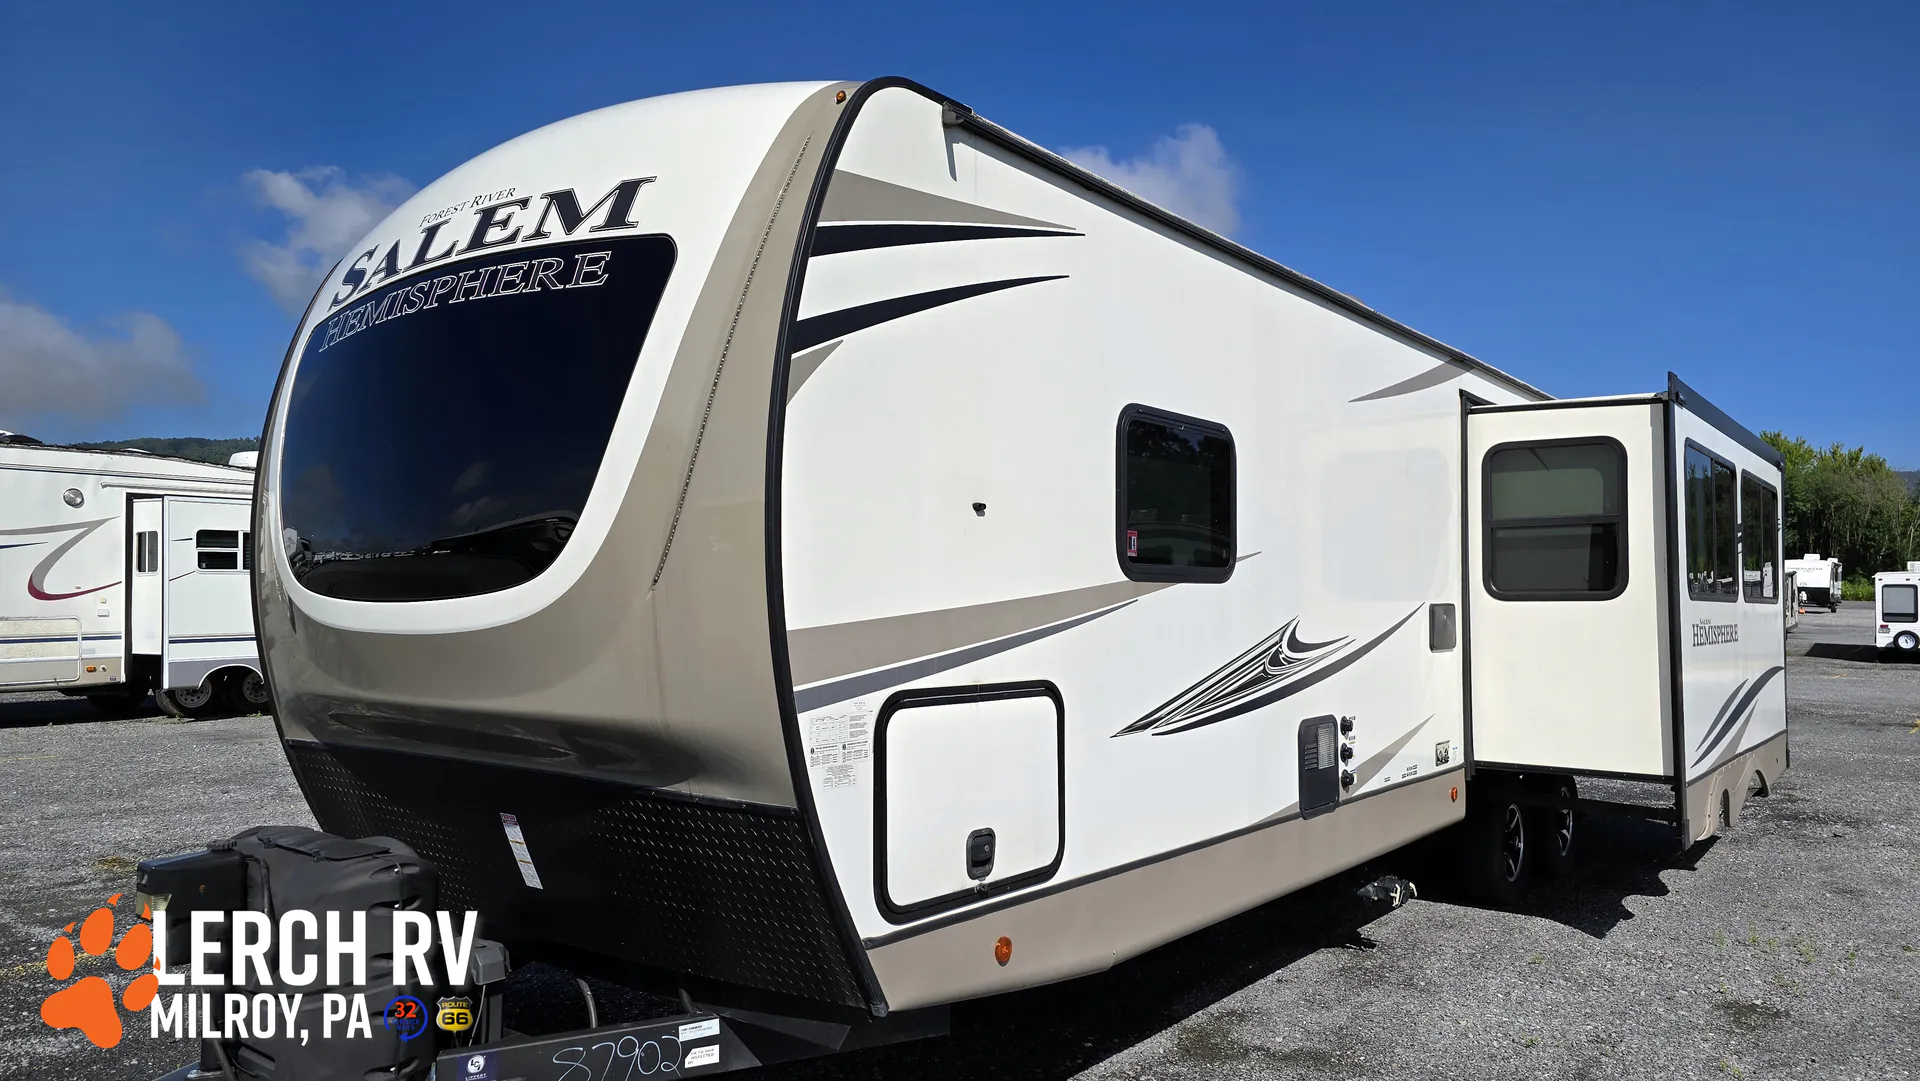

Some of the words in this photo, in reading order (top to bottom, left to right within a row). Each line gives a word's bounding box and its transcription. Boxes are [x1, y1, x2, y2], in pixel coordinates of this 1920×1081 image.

[419, 200, 470, 228] FOREST
[469, 187, 516, 209] RIVER
[328, 176, 657, 312] SALEM
[319, 250, 612, 353] HEMISPHERE
[1691, 623, 1739, 647] HEMISPHERE
[552, 1035, 682, 1081] 87902
